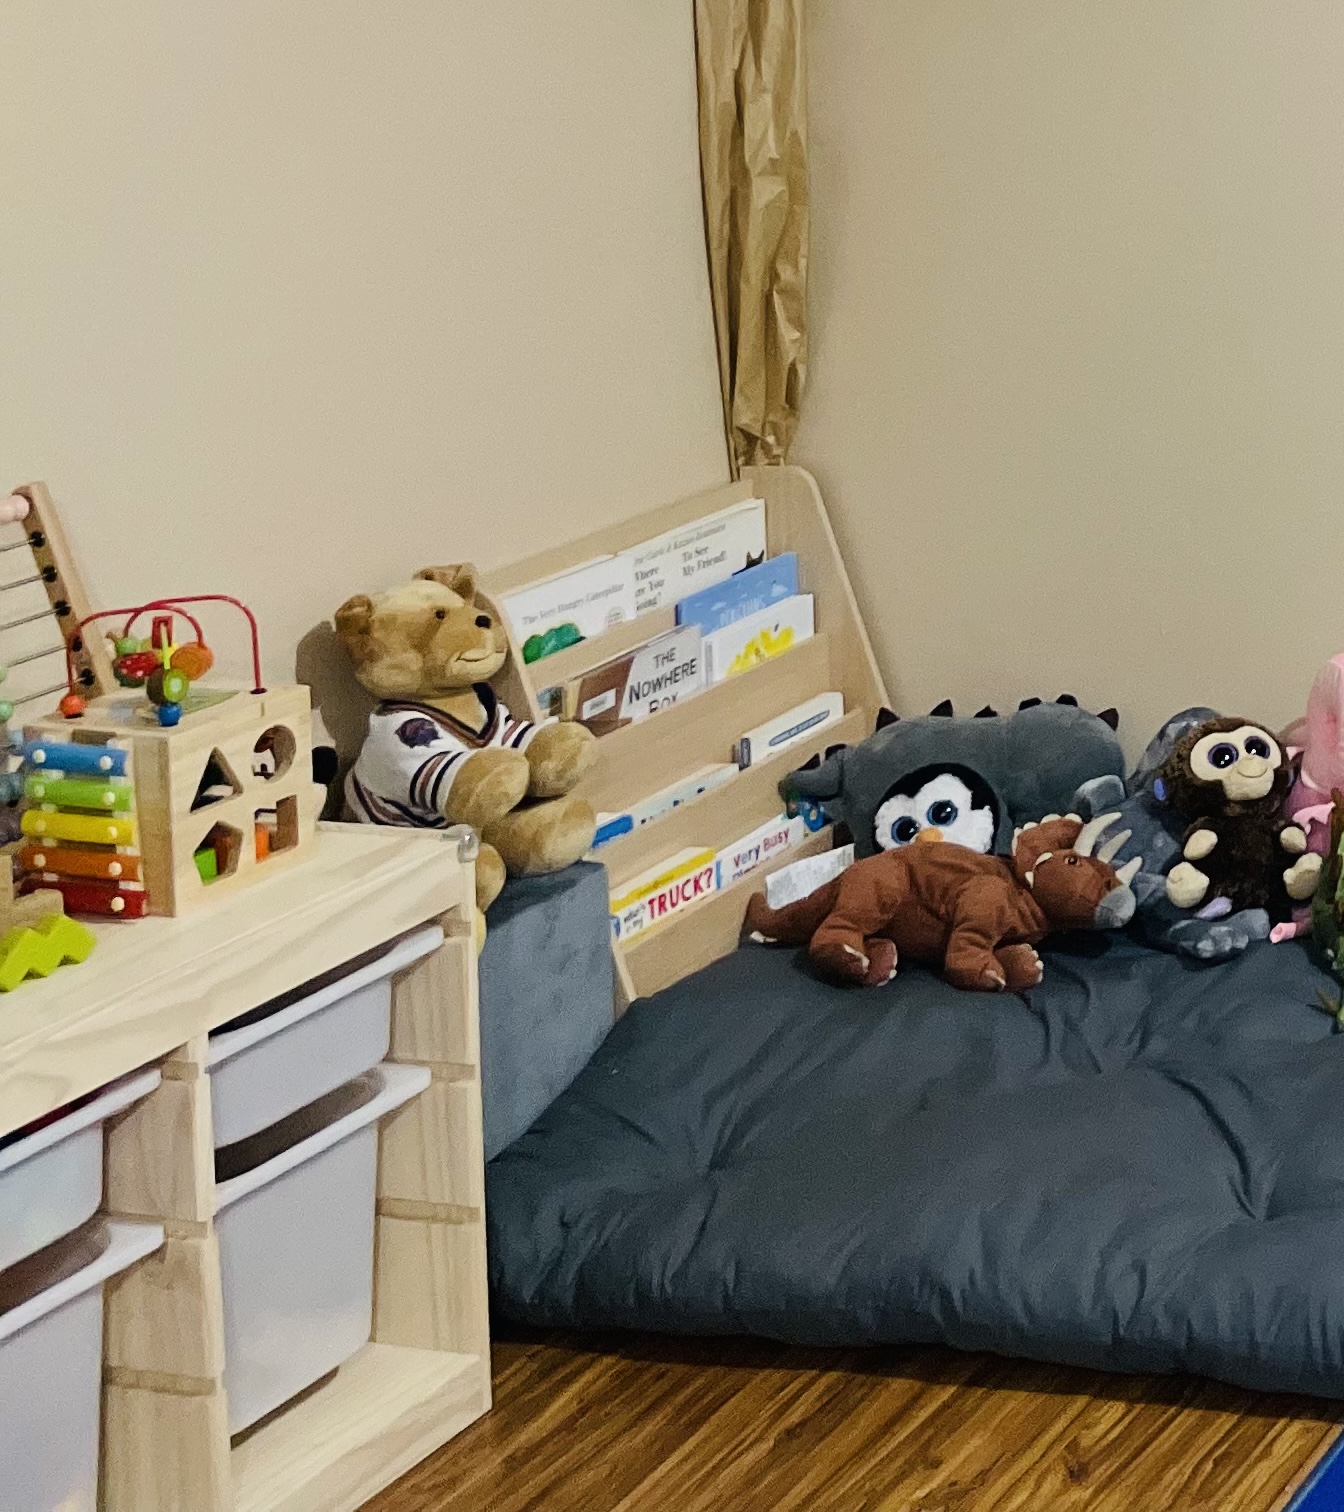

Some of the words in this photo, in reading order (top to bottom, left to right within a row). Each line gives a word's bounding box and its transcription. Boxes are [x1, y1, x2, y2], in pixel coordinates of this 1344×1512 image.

[653, 646, 677, 669] THE
[628, 657, 698, 705] NOWHERE
[732, 843, 761, 869] Very
[647, 867, 714, 920] TRUCK?
